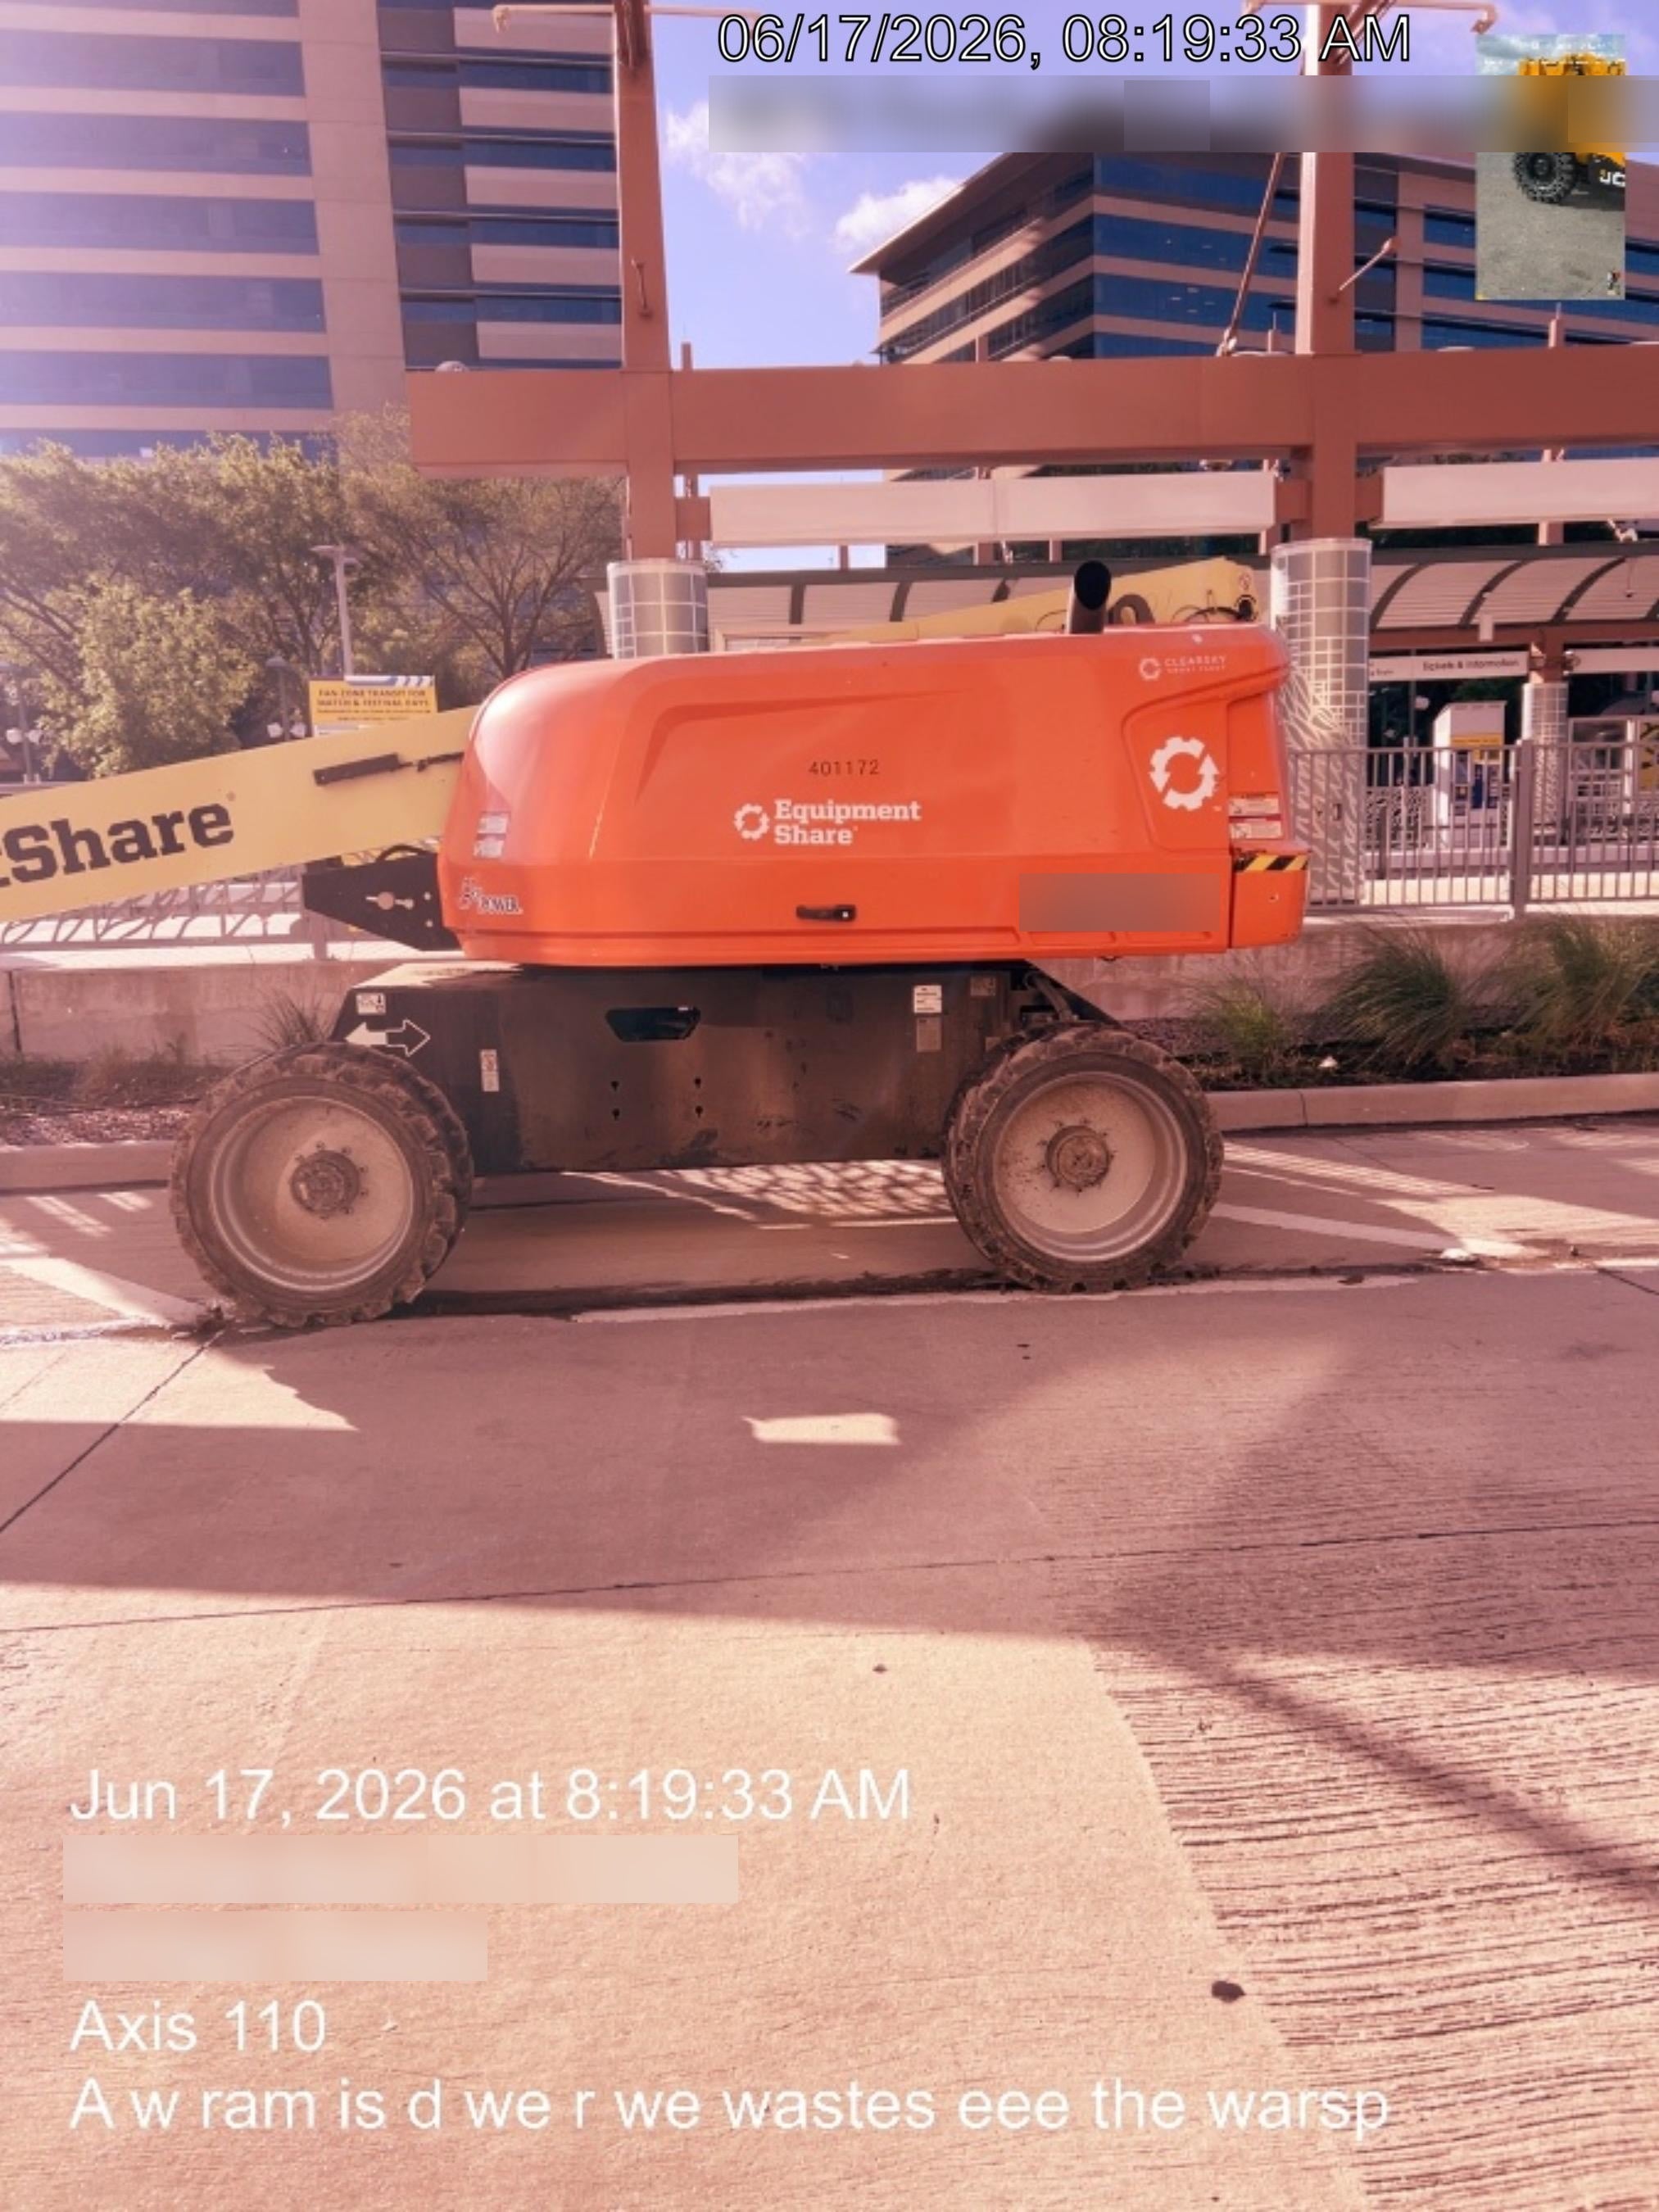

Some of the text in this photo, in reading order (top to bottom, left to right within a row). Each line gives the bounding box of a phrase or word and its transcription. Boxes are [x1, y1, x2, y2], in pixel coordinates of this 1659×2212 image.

[368, 689, 406, 697] TRANSIT
[809, 759, 880, 776] 401172
[773, 798, 922, 823] Equipment
[0, 803, 234, 886] Share
[773, 824, 854, 846] Share
